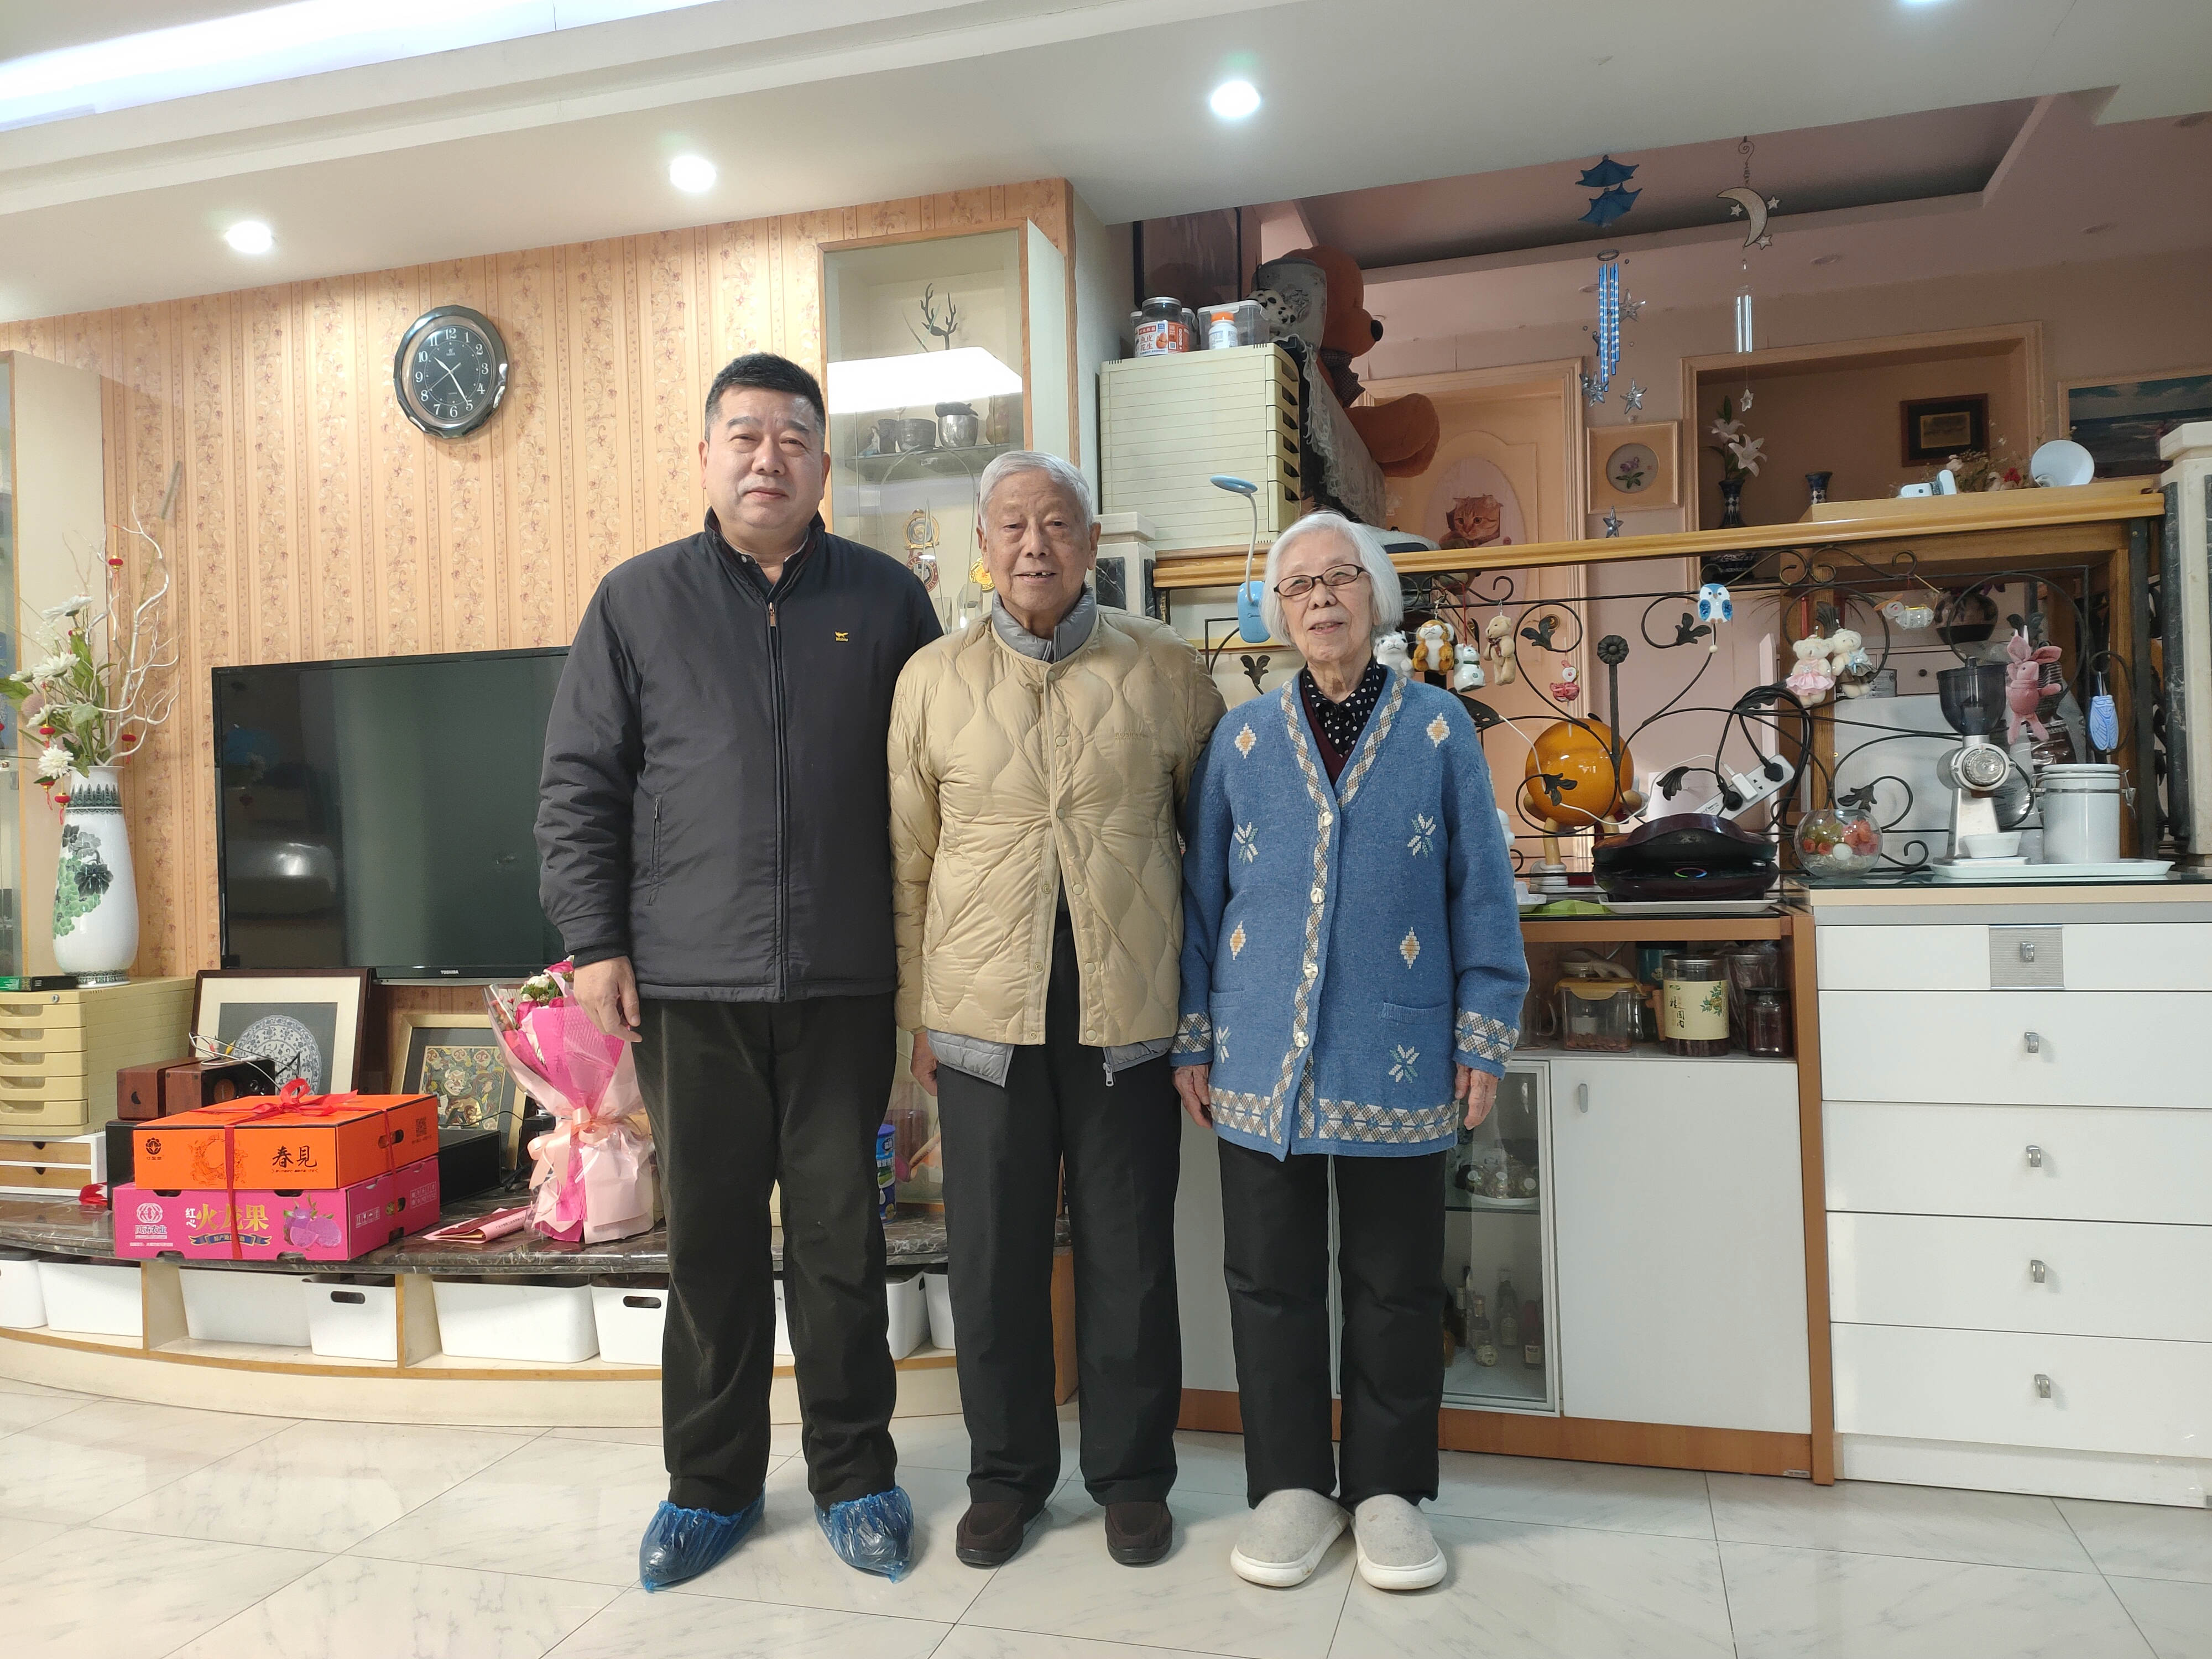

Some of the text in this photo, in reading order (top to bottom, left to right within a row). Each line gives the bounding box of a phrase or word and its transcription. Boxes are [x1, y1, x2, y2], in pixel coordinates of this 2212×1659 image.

[445, 328, 457, 340] 12
[465, 332, 470, 343] 1
[430, 335, 438, 346] 11
[476, 344, 483, 355] 2
[419, 351, 428, 363] 10
[481, 363, 489, 375] 3
[415, 371, 423, 383] 9
[477, 383, 486, 394] 4
[421, 390, 429, 401] 8
[433, 404, 441, 415] 7
[466, 400, 473, 411] 5
[450, 405, 458, 418] 6
[185, 1207, 196, 1228] 红心
